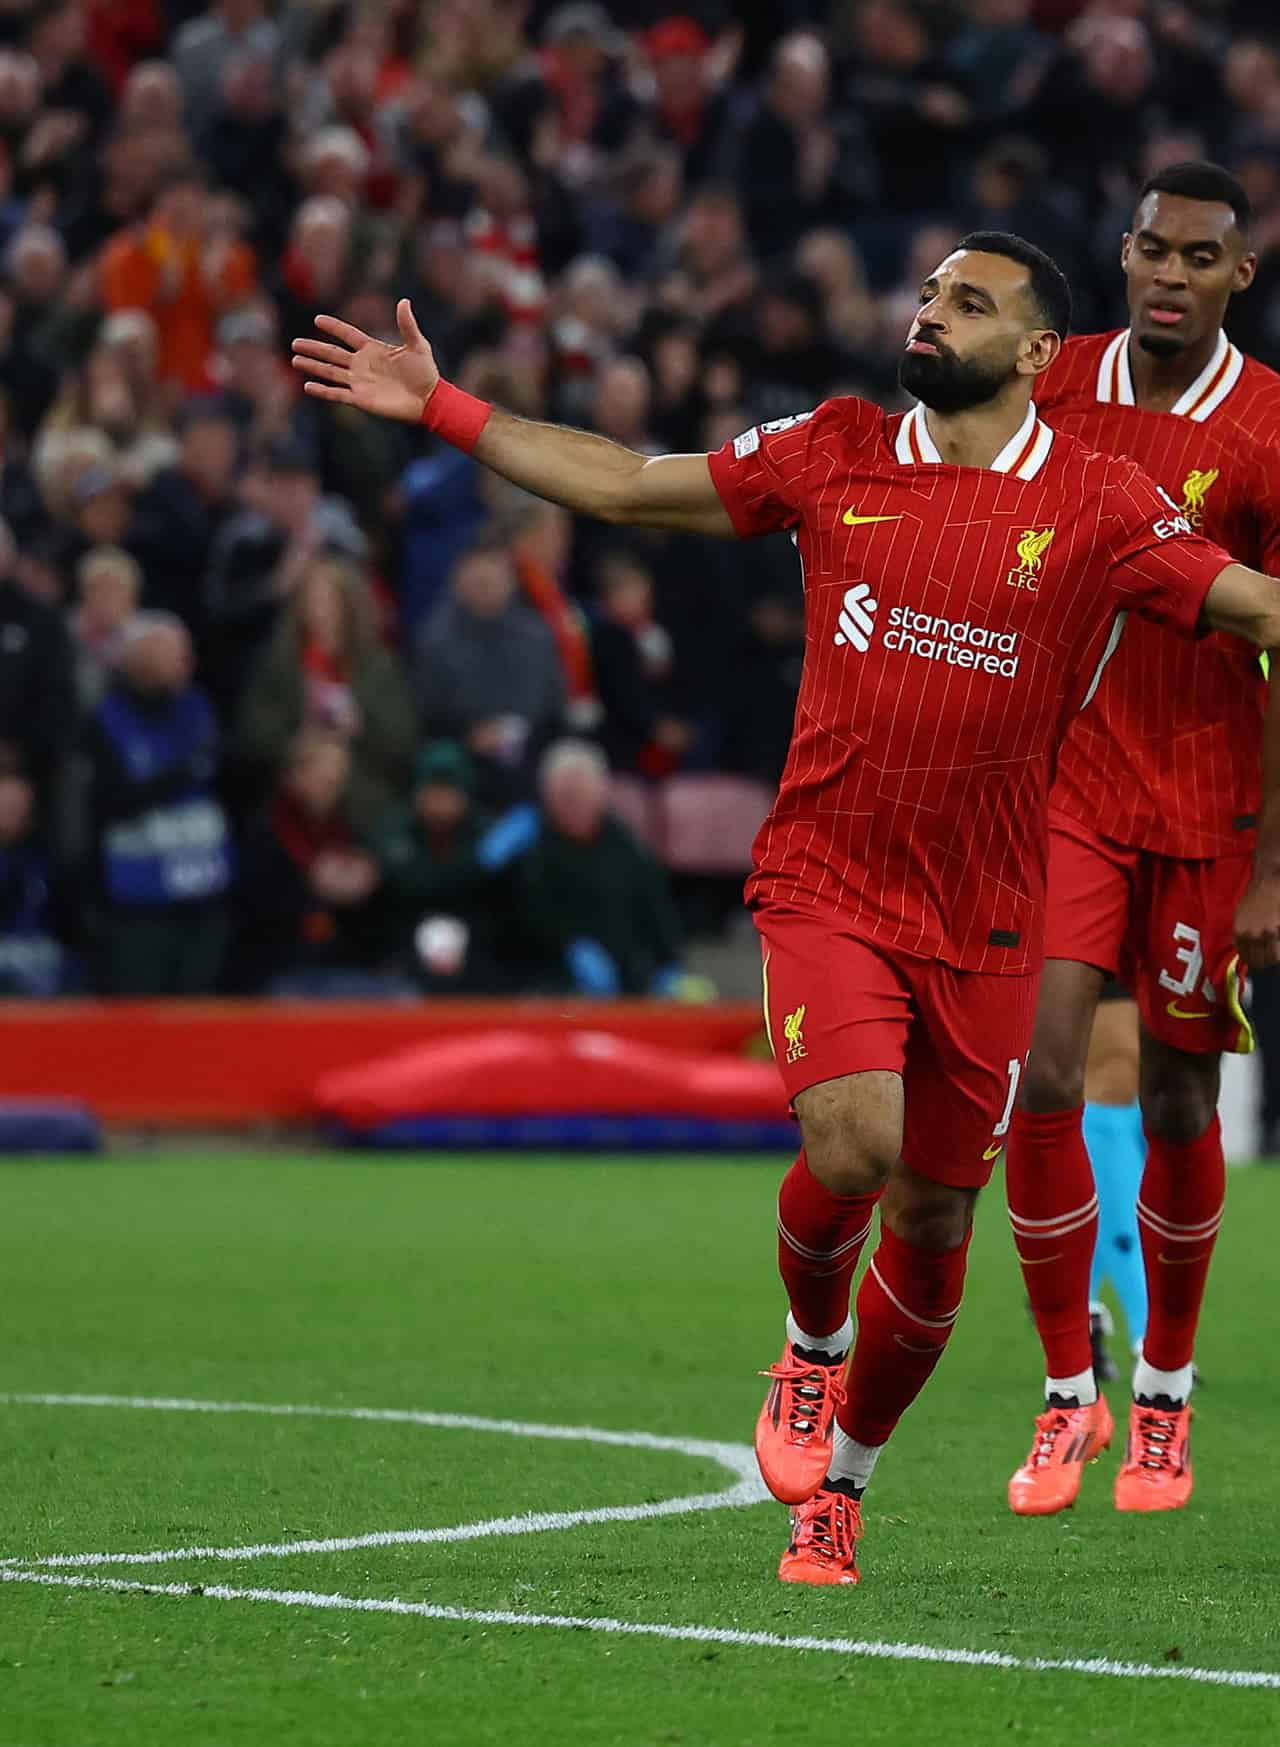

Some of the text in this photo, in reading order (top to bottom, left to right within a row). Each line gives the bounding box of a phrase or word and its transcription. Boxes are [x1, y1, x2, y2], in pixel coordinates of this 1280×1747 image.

[883, 629, 1019, 678] chartered
[888, 606, 1018, 654] standard
[1158, 921, 1217, 1002] 3
